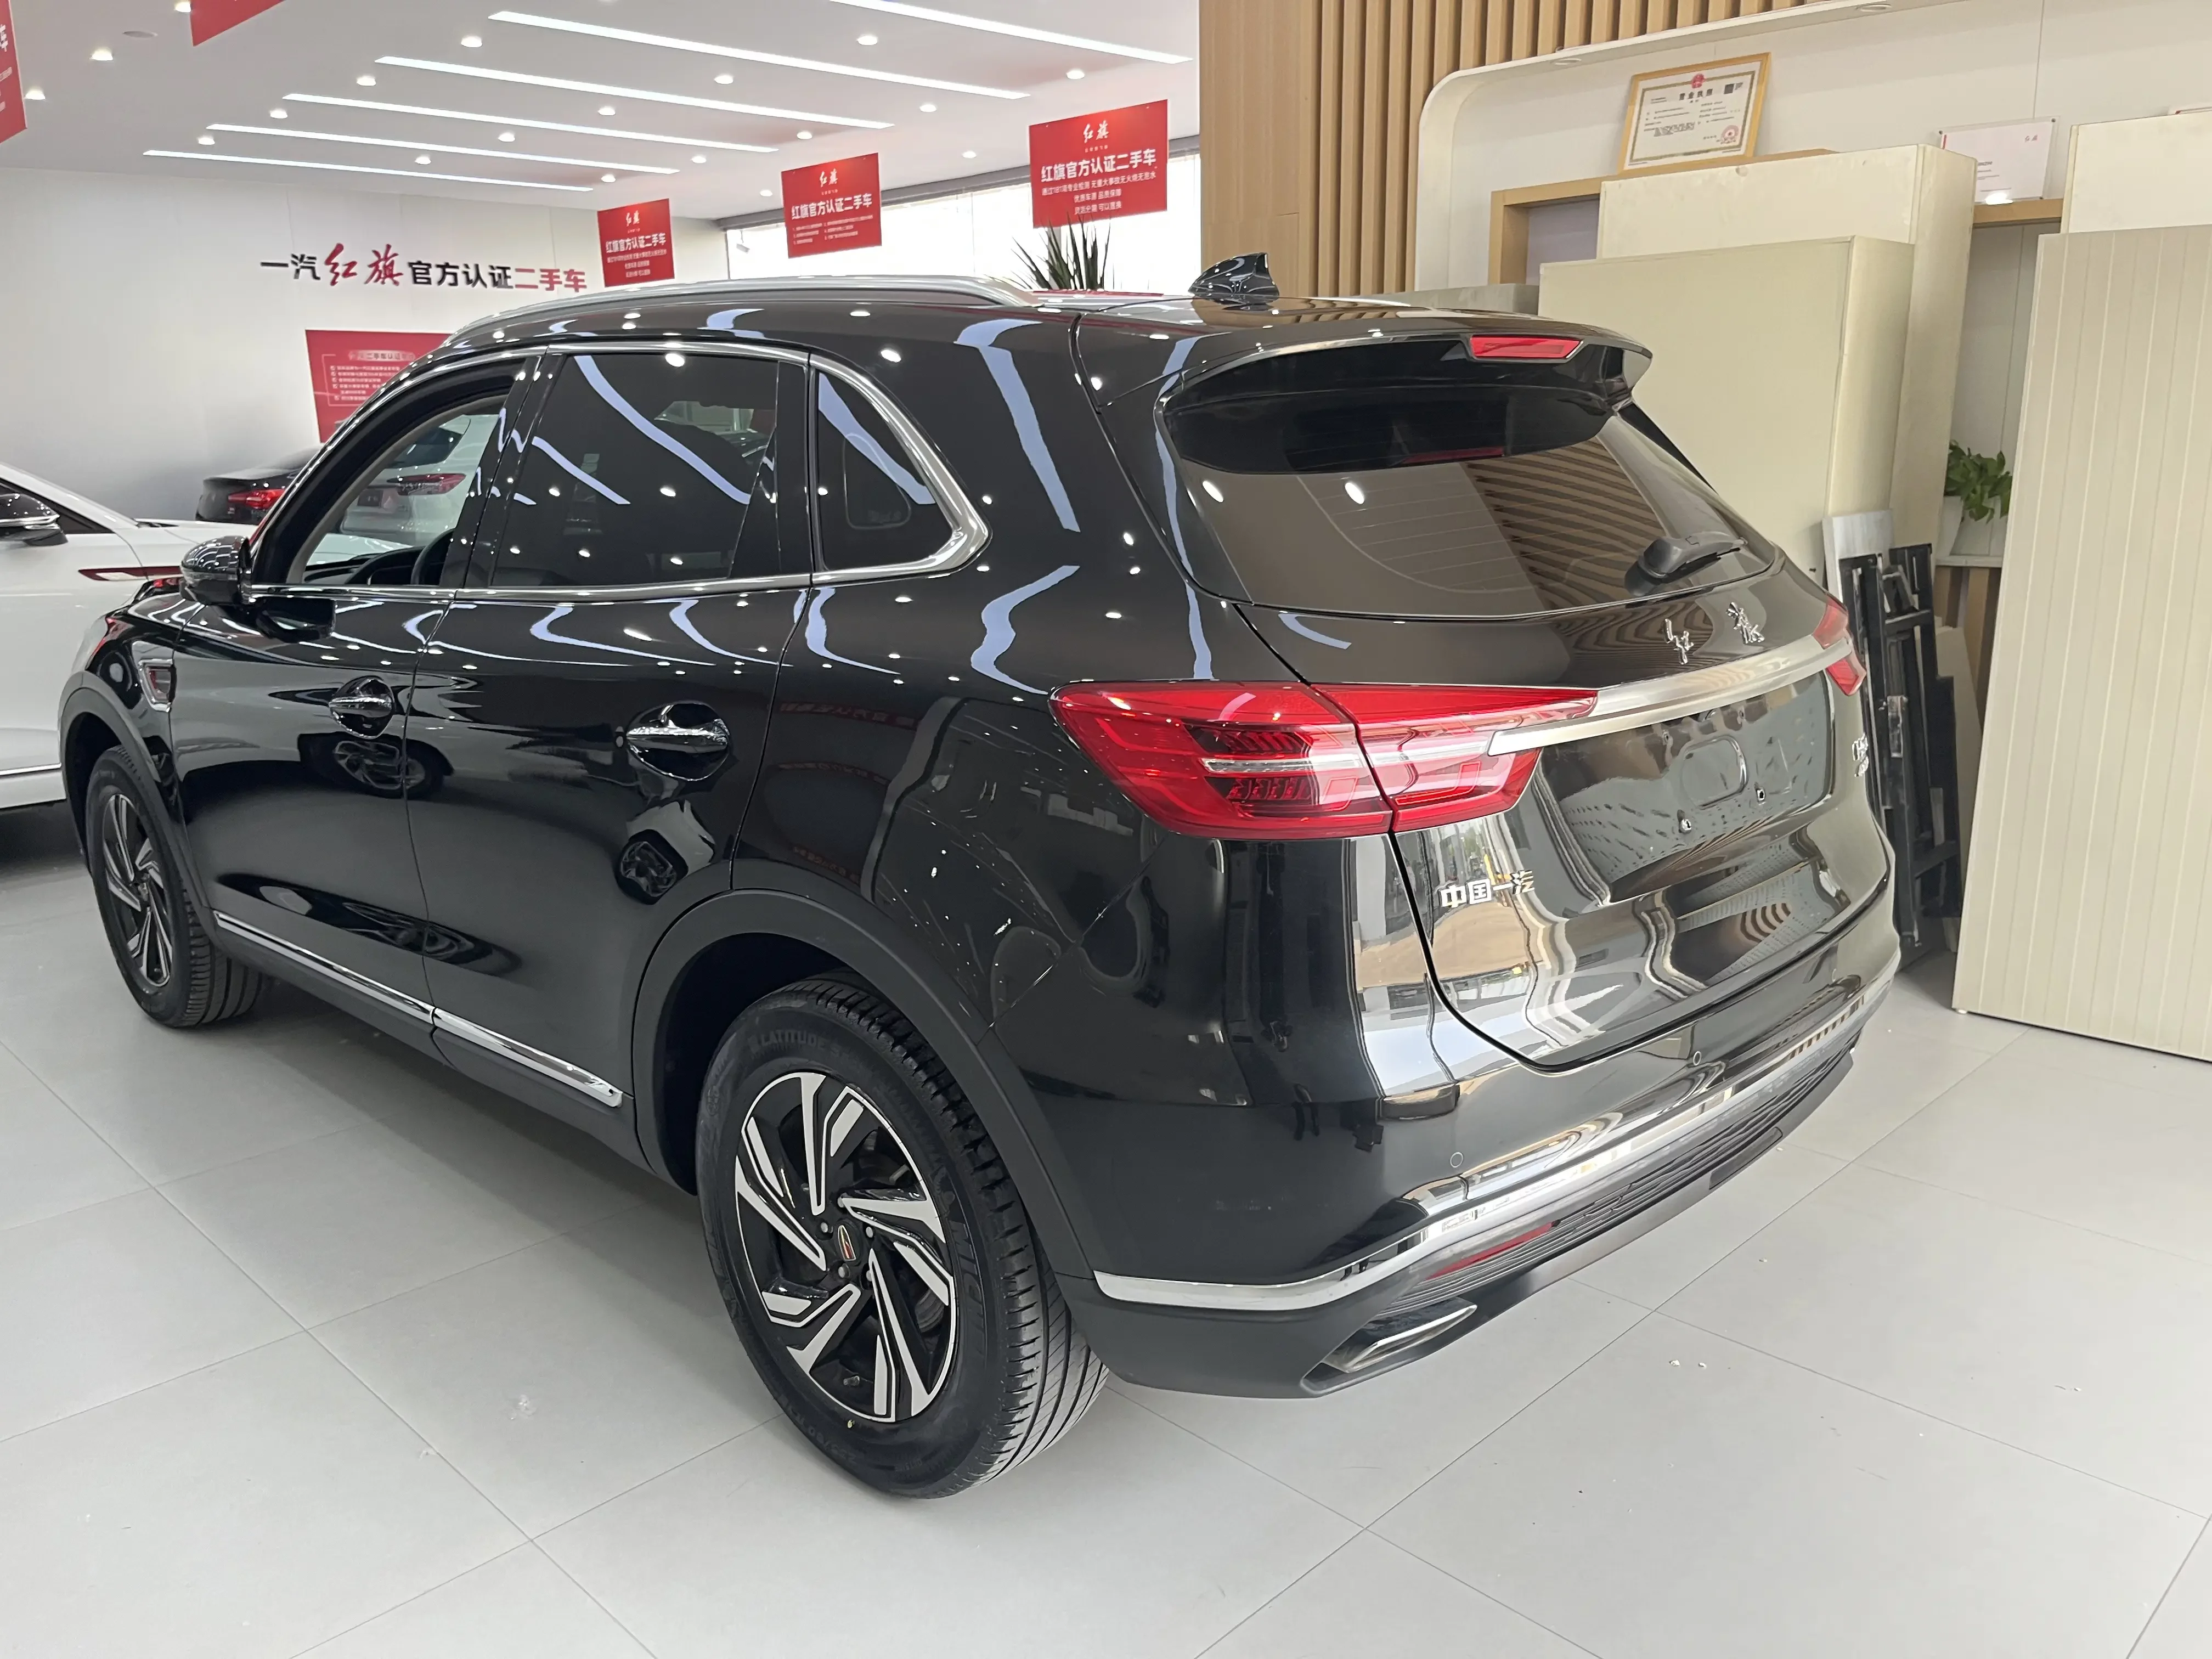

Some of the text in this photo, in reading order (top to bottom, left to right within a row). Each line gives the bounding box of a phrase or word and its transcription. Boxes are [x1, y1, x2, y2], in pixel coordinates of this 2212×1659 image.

[1041, 149, 1156, 182] 红旗官方认证二手车
[792, 193, 872, 220] 红旗官方认证二手车
[1438, 870, 1535, 908] 中国一汽
